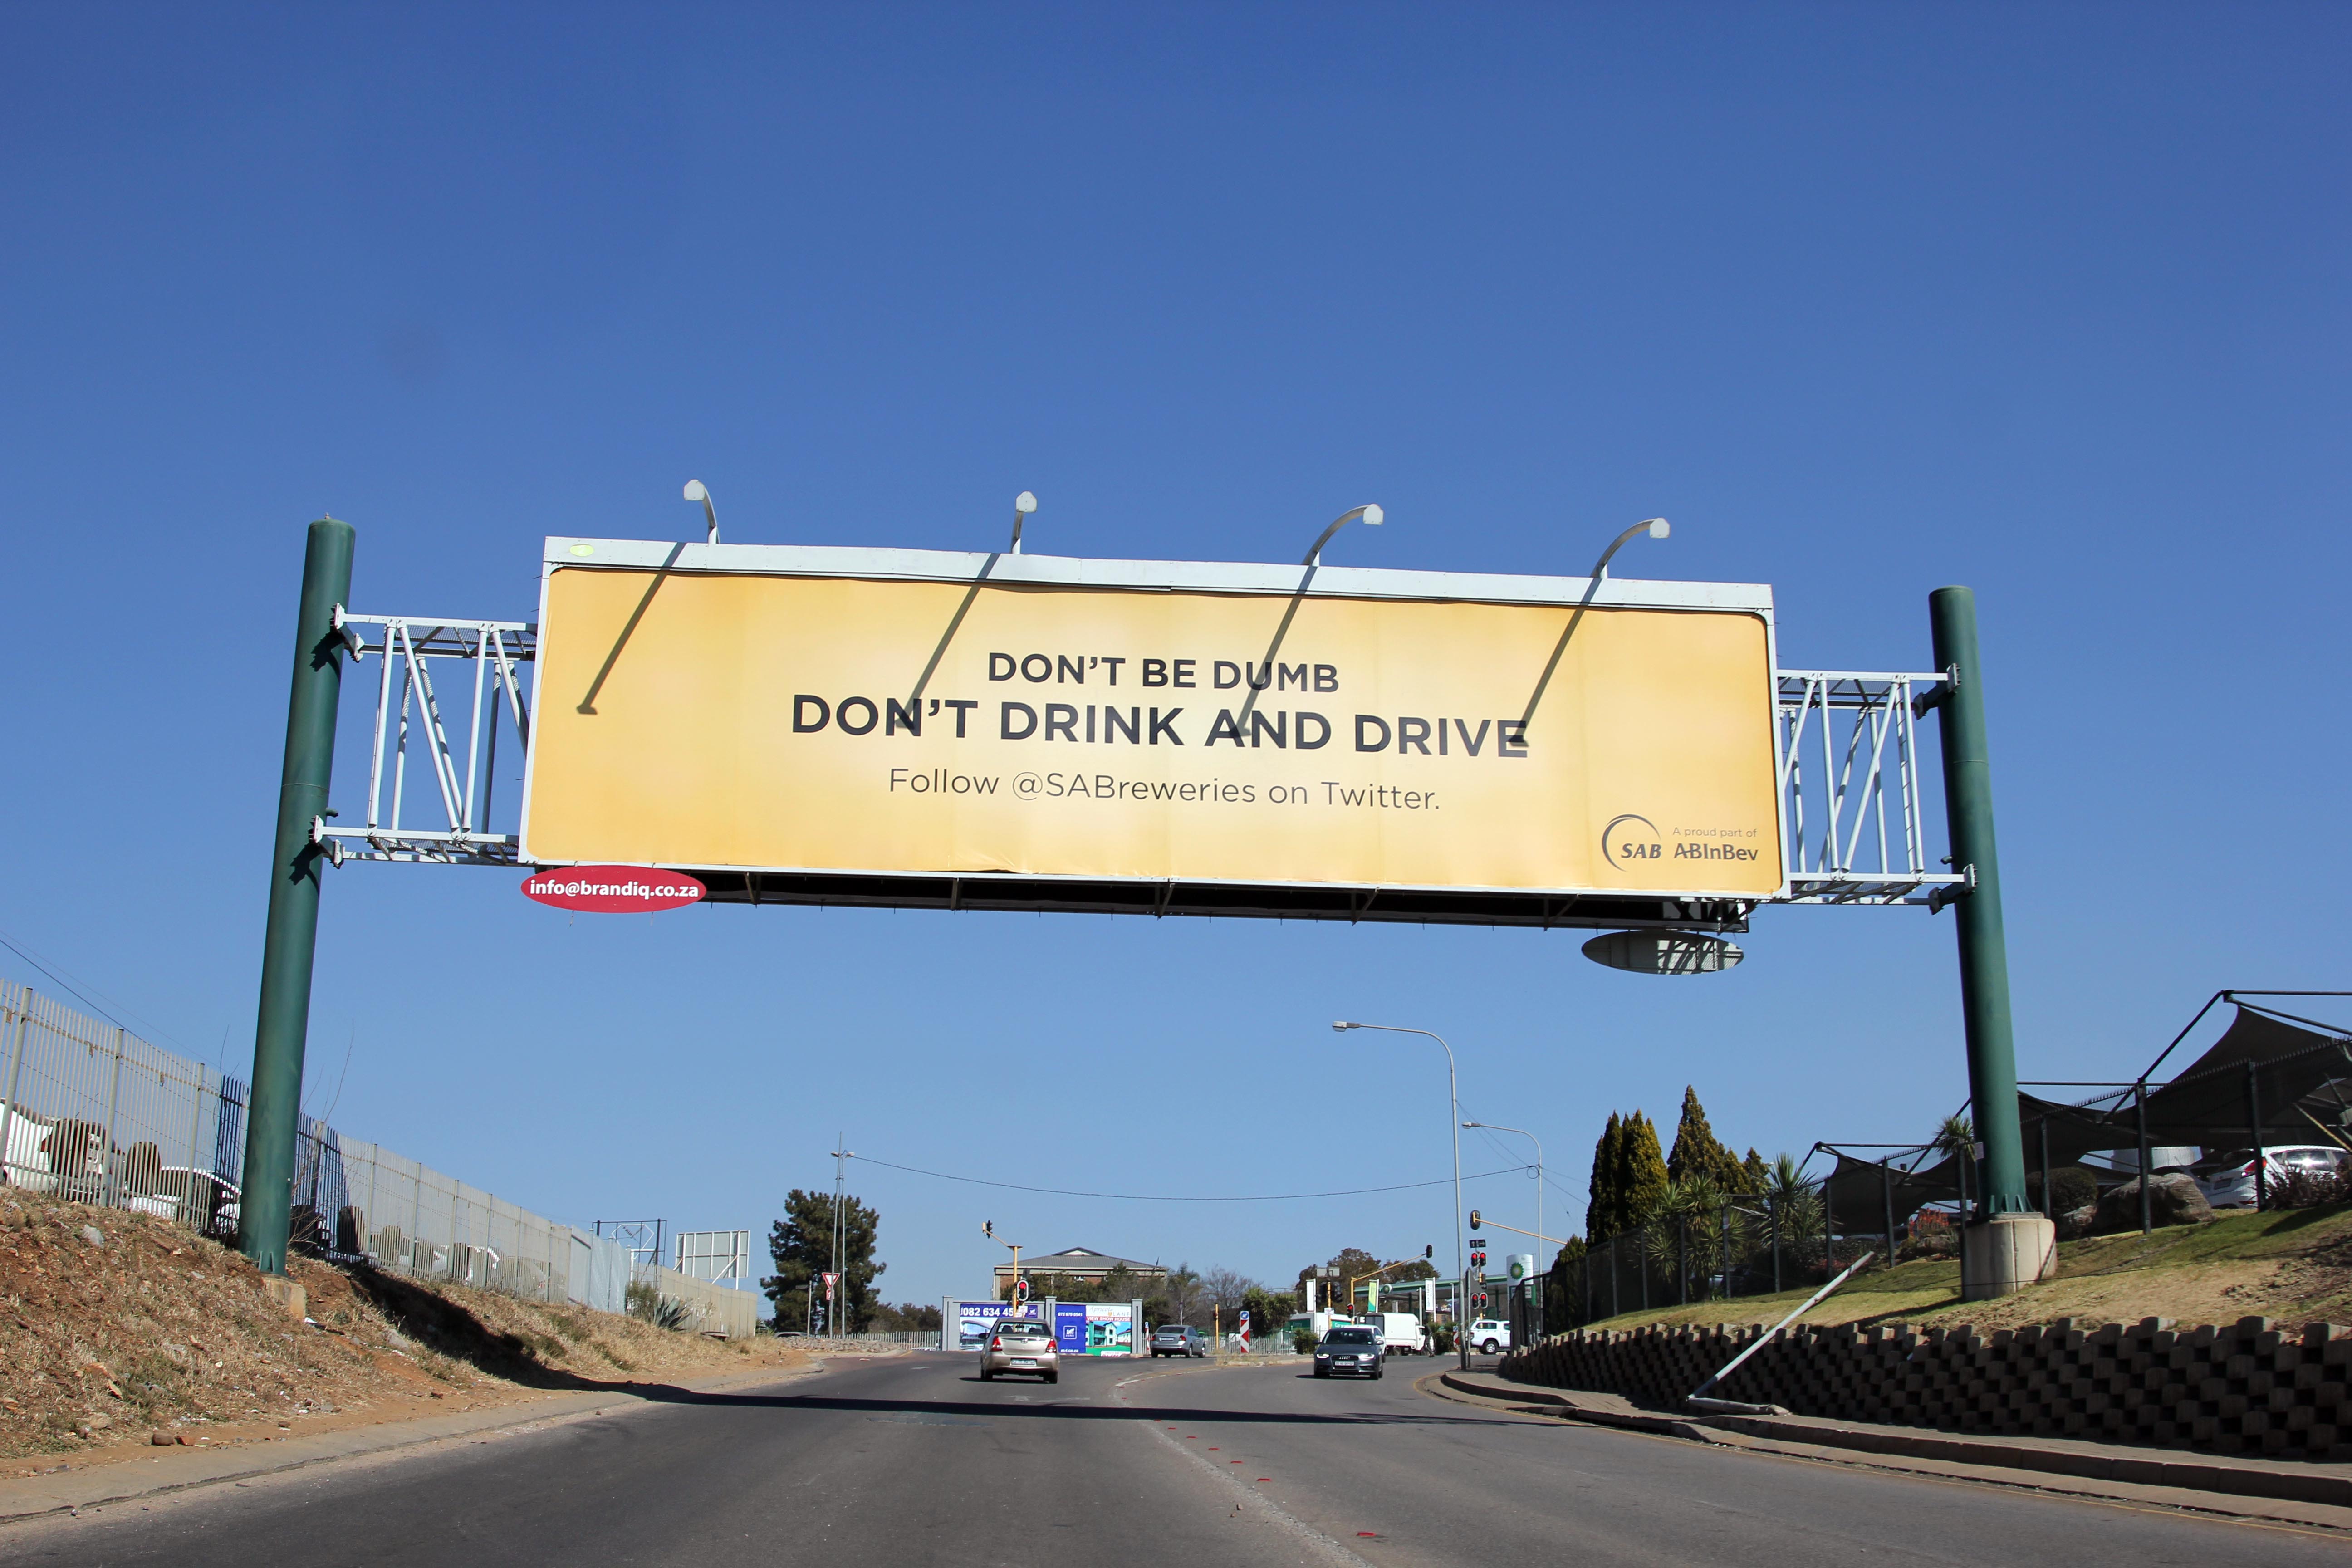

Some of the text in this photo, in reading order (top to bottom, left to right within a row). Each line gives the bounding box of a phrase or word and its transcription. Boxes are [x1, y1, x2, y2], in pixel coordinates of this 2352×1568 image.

[989, 652, 1338, 692] DON’T BE DUMB
[793, 695, 1528, 758] DON’T DRINK AND DRIVE
[890, 769, 1439, 809] Follow @SABreweries on Twitter.
[1673, 827, 1758, 838] A proud part of
[1621, 843, 1661, 859] SAB
[1674, 843, 1759, 861] ABInBev
[530, 879, 699, 900] info@brandiq.co.za
[963, 1307, 980, 1316] 082
[983, 1307, 1000, 1317] 634
